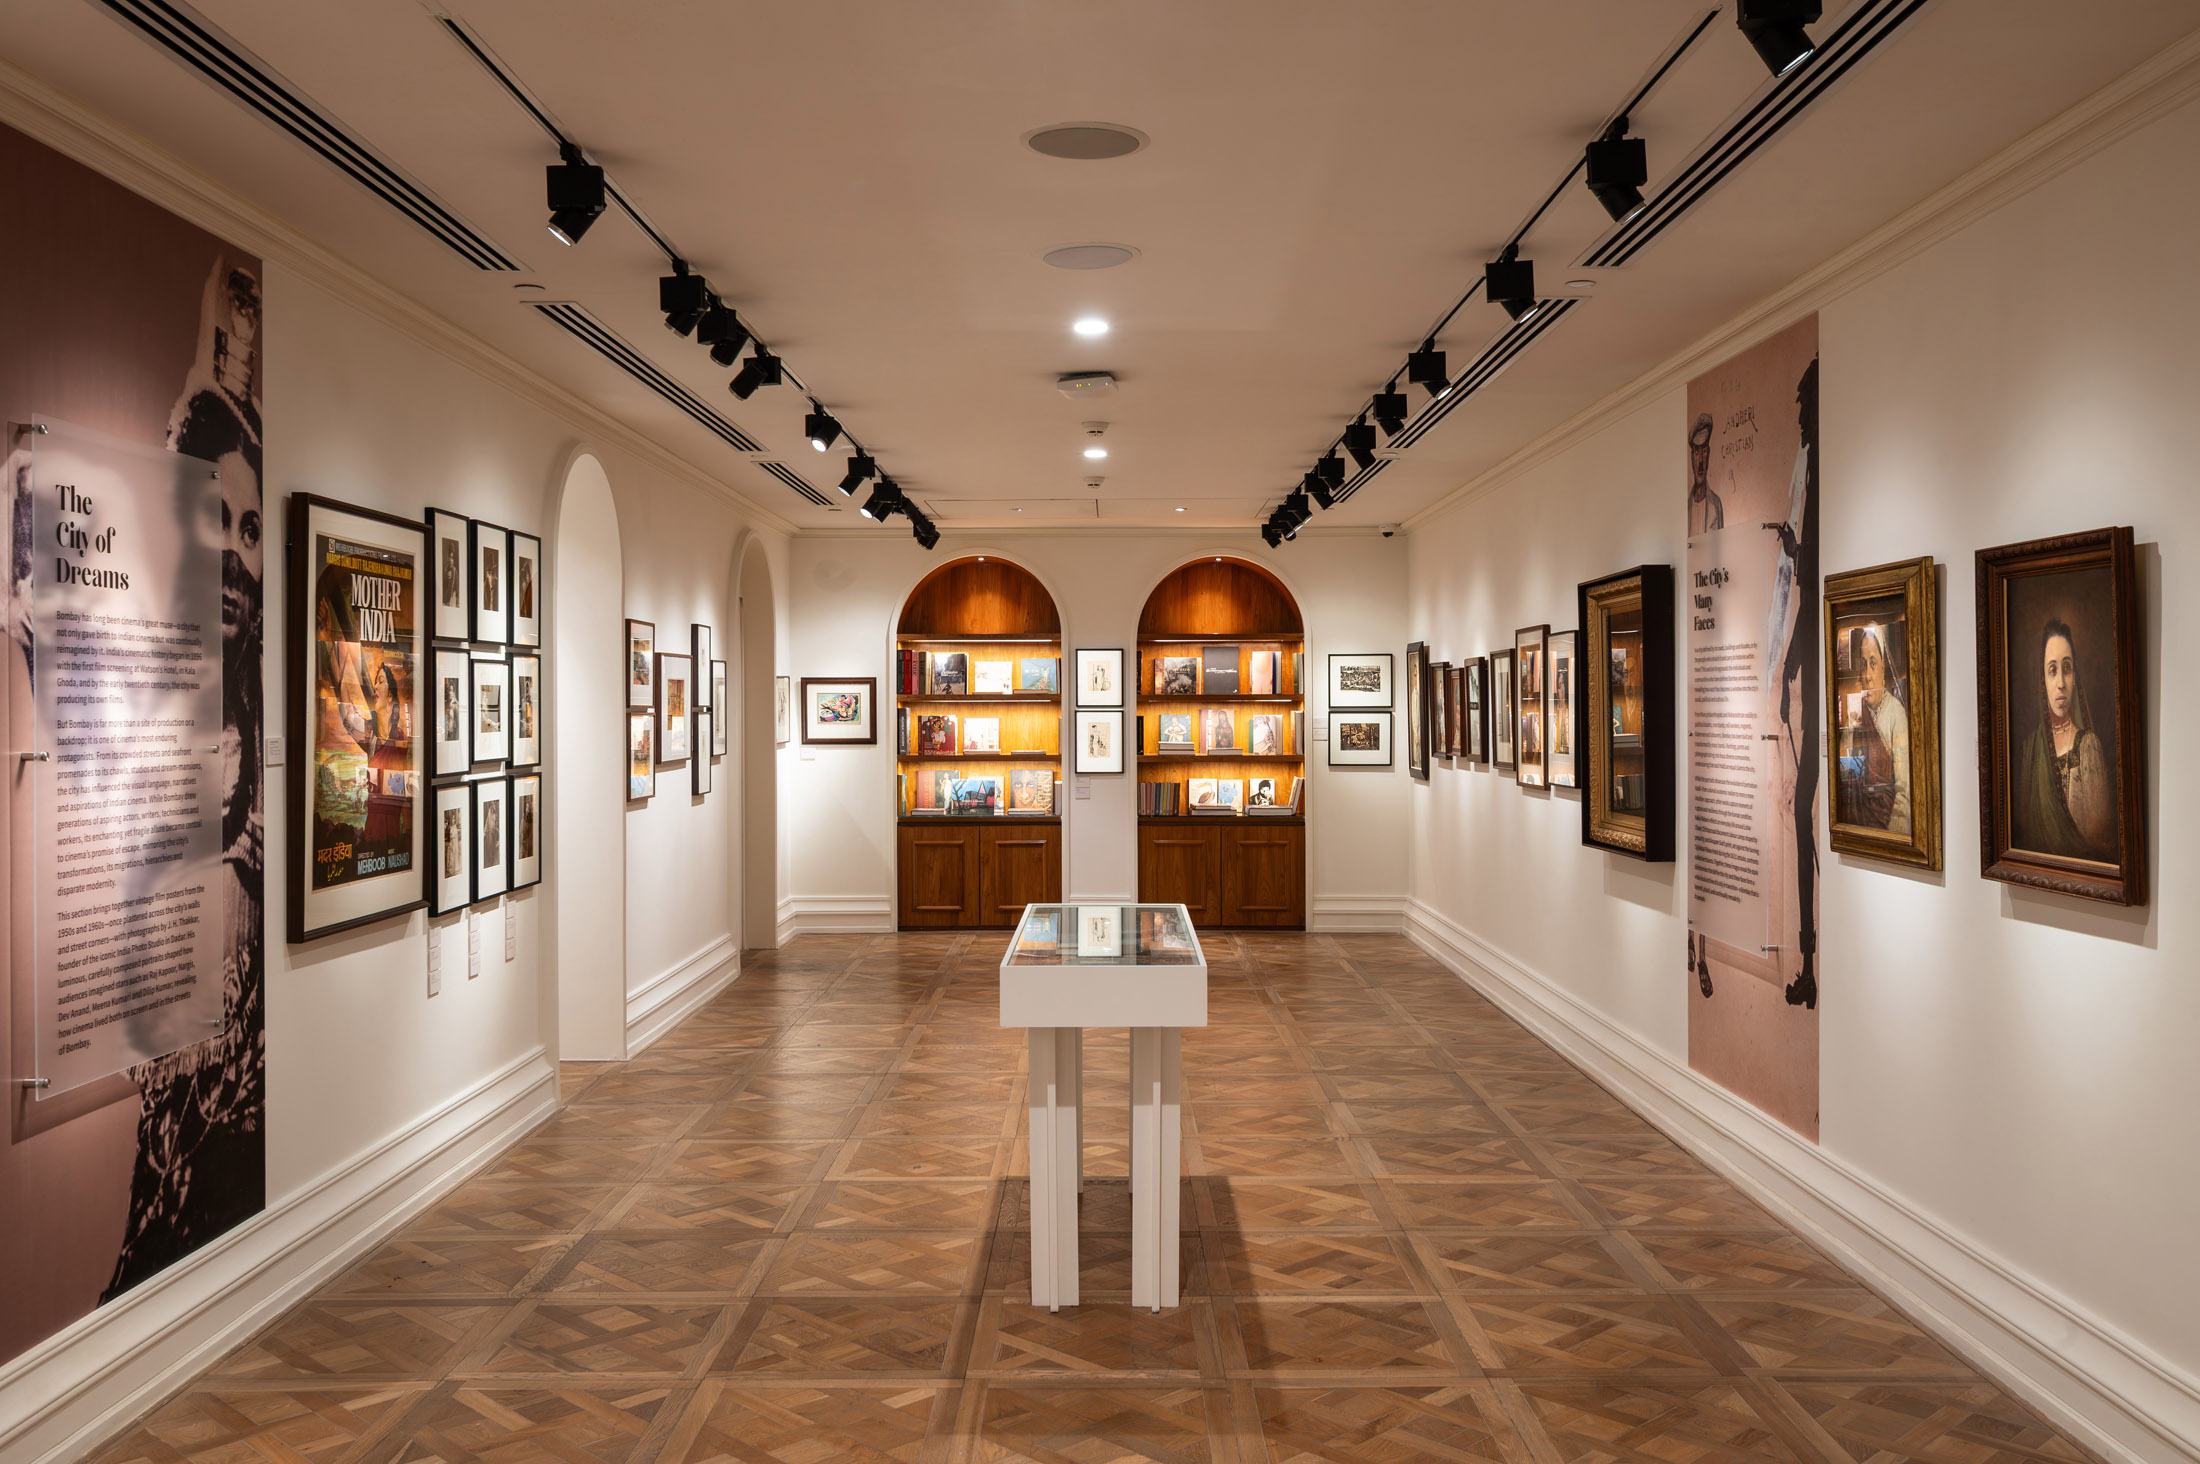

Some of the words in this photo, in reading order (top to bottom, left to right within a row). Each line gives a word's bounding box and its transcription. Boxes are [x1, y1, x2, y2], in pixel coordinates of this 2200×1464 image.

[1722, 405, 1758, 434] ANDHERI
[1721, 434, 1754, 459] CHRISTIAN
[56, 484, 92, 515] The
[57, 521, 90, 557] City
[96, 526, 116, 553] of
[57, 557, 129, 590] Dreams
[1694, 571, 1708, 588] The
[351, 573, 401, 611] MOTHER
[1694, 594, 1712, 612] Many
[56, 611, 80, 623] Bombay
[93, 614, 105, 625] long
[360, 608, 396, 643] INDIA
[1694, 616, 1715, 631] Faces
[67, 629, 80, 639] only
[96, 630, 109, 638] birth
[118, 631, 134, 640] Indian
[56, 645, 89, 655] reimagined
[125, 648, 150, 656] cinematic
[56, 662, 70, 670] with
[71, 662, 80, 670] the
[82, 662, 93, 671] first
[94, 663, 105, 671] film
[106, 664, 132, 674] screening
[79, 678, 90, 686] and
[57, 694, 86, 705] producing
[57, 720, 67, 728] But
[68, 719, 92, 729] Bombay
[157, 718, 184, 728] production
[57, 736, 86, 746] backdrop;
[154, 734, 177, 743] enduring
[57, 752, 95, 763] protagonists.
[119, 749, 142, 758] crowded
[57, 768, 93, 780] promenades
[130, 765, 149, 773] studios
[57, 786, 67, 794] the
[68, 786, 79, 795] city
[92, 782, 120, 792] influenced
[121, 781, 130, 789] the
[131, 780, 146, 788] visual
[147, 780, 171, 789] language,
[57, 802, 68, 811] and
[70, 800, 101, 811] aspirations
[109, 798, 126, 806] Indian
[148, 794, 162, 802] While
[163, 792, 183, 801] Bombay
[57, 818, 91, 830] generations
[99, 814, 122, 825] aspiring
[56, 835, 82, 844] workers,
[92, 830, 123, 840] enchanting
[133, 826, 149, 836] fragile
[91, 847, 114, 858] promise
[388, 852, 409, 868] NAUSHAD
[57, 865, 105, 878] transformations,
[114, 859, 144, 870] migrations,
[358, 857, 386, 875] MEHBOOB
[57, 885, 84, 896] disparate
[85, 880, 116, 890] modernity.
[57, 911, 69, 920] This
[71, 908, 92, 917] section
[93, 904, 110, 913] brings
[111, 899, 134, 910] together
[135, 896, 154, 904] vintage
[155, 892, 164, 901] film
[166, 890, 184, 900] posters
[57, 927, 74, 937] 1950s
[123, 910, 147, 925] plastered
[148, 909, 164, 917] across
[165, 906, 173, 914] the
[188, 900, 200, 909] walls
[70, 941, 87, 951] street
[127, 924, 159, 940] photographs
[58, 959, 80, 970] founder
[89, 954, 98, 962] the
[99, 950, 116, 960] iconic
[117, 947, 130, 956] India
[131, 943, 146, 952] Photo
[148, 939, 164, 948] Studio
[58, 975, 87, 987] luminous,
[88, 966, 112, 979] carefully
[113, 958, 140, 972] composed
[141, 954, 163, 967] portraits
[164, 948, 182, 959] shaped
[58, 991, 87, 1004] audiences
[88, 981, 114, 995] imagined
[115, 979, 128, 988] stars
[149, 970, 157, 979] Raj
[158, 967, 177, 976] Kapoor,
[58, 1012, 69, 1020] Dev
[70, 1005, 91, 1017] Anand,
[92, 1001, 110, 1011] Meena
[111, 993, 131, 1005] Kumari
[142, 987, 154, 996] Dilip
[155, 984, 173, 992] Kumar,
[174, 976, 196, 987] revealing
[58, 1028, 71, 1037] how
[72, 1021, 93, 1032] cinema
[94, 1014, 108, 1026] lived
[109, 1010, 121, 1021] both
[130, 1005, 148, 1015] screen
[174, 991, 191, 1001] streets
[66, 1041, 91, 1052] Bombay.
